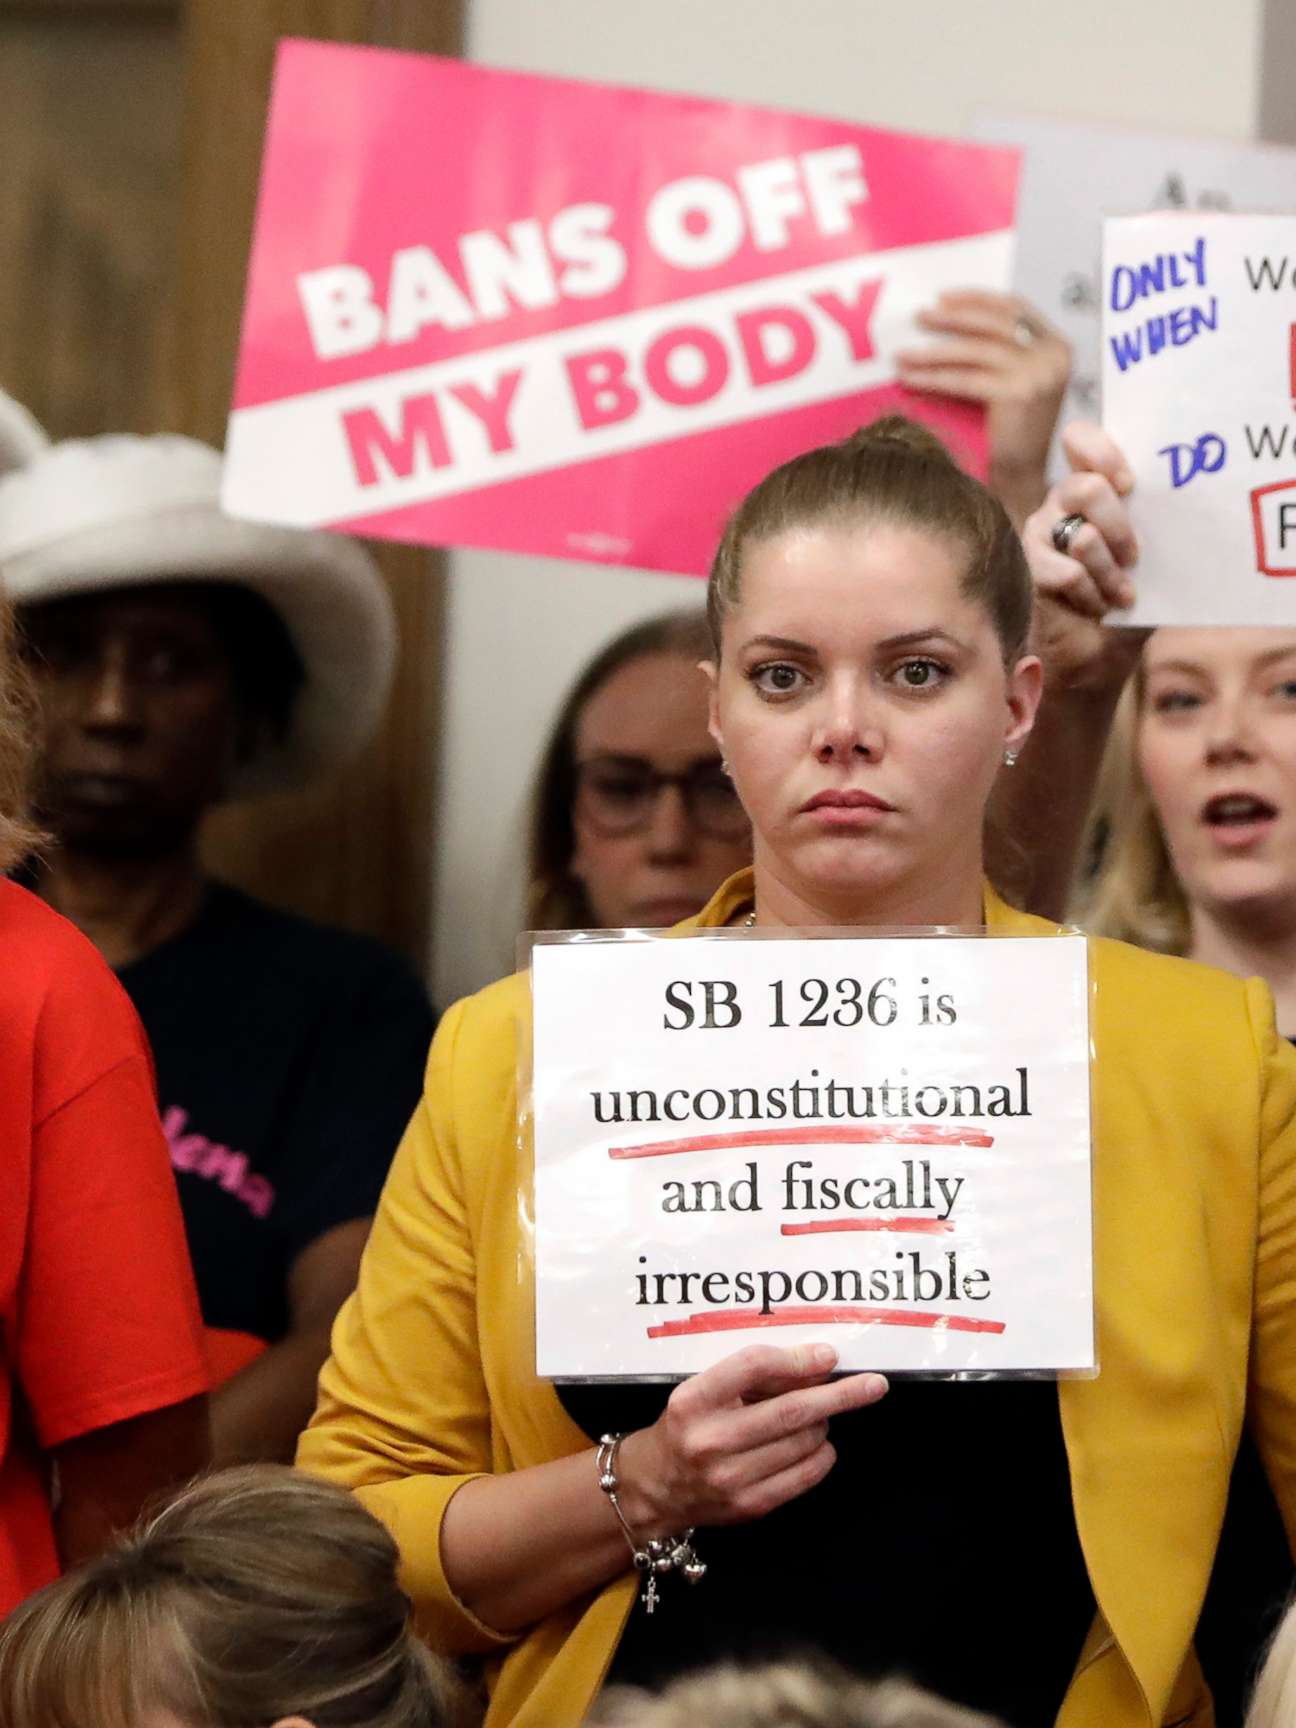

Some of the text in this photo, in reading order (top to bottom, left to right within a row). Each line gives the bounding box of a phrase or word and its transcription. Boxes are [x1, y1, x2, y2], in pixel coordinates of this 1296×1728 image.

[299, 145, 866, 360] BANS OFF
[1110, 238, 1206, 312] ONLY
[1110, 296, 1218, 372] WHEN
[341, 275, 882, 486] MY BODY
[1160, 433, 1227, 489] DO
[662, 976, 958, 1031] SB 1236 is
[590, 1067, 1033, 1123] unconstitutional
[661, 1159, 965, 1221] and fiscally
[634, 1250, 992, 1316] irresponsible
